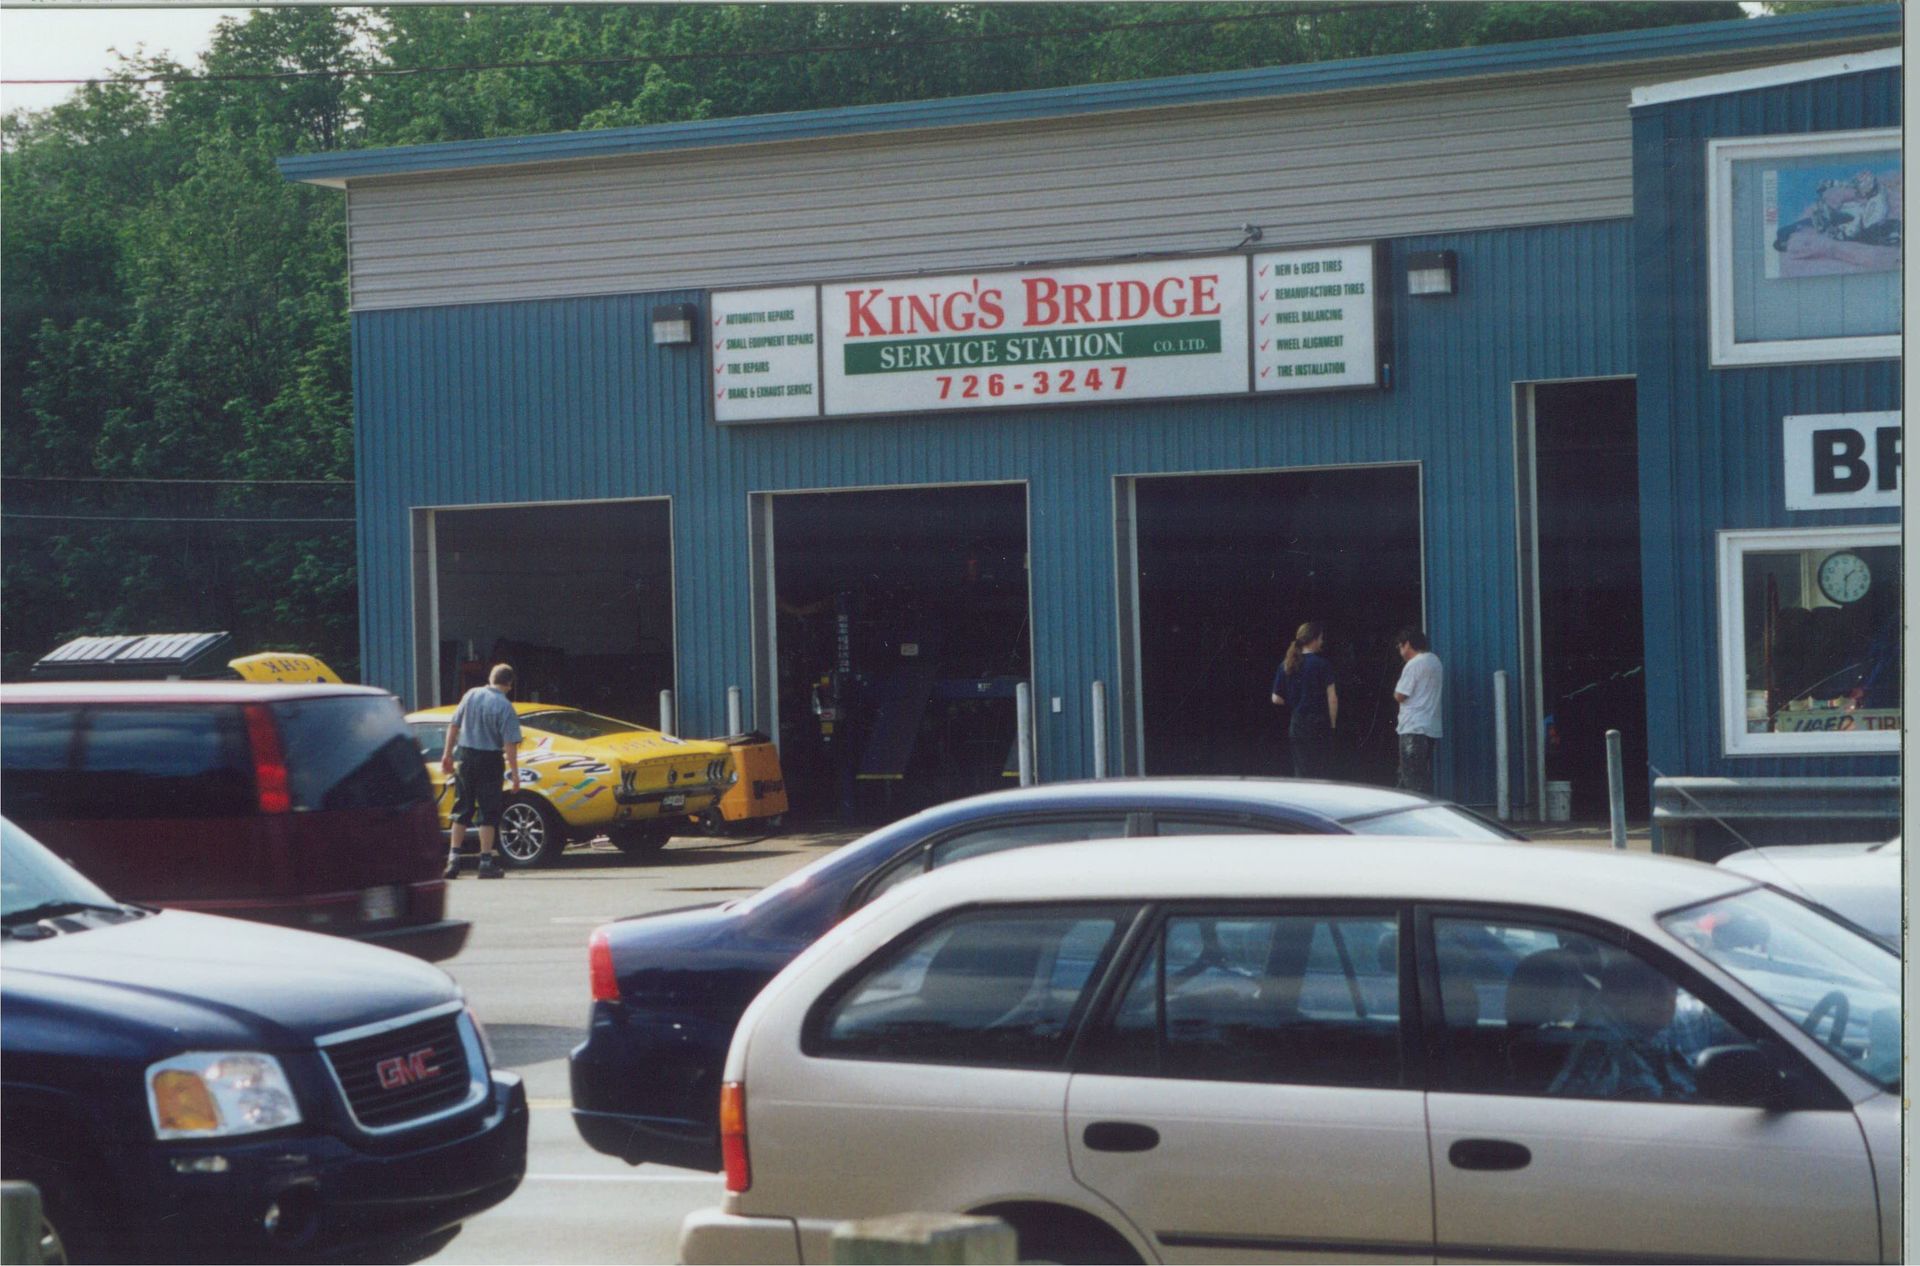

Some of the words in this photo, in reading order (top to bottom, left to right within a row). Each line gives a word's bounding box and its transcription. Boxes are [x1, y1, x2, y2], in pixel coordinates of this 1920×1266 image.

[1275, 264, 1292, 276] NEW
[1293, 262, 1300, 275] &
[1301, 261, 1321, 274] USED
[1322, 260, 1343, 272] TIRES
[1275, 285, 1342, 300] REMANUFACTURED
[1344, 283, 1366, 295] TIRES
[845, 279, 1006, 337] KING'S
[1022, 274, 1222, 326] BRIDGE
[726, 312, 766, 325] AUTOMOTIVE
[767, 310, 794, 322] REPAIRS
[1276, 312, 1300, 324] WHEEL
[1301, 309, 1343, 322] BALANCING
[726, 338, 747, 350] SMALL
[748, 335, 785, 348] EQUIPMENT
[786, 333, 814, 346] REPAIRS
[1276, 338, 1301, 350] WHEEL
[1302, 335, 1343, 349] ALIGNMENT
[880, 341, 999, 369] SERVICE
[1006, 332, 1125, 361] STATION
[1153, 340, 1176, 352] CO.
[1180, 338, 1208, 351] LTD.
[727, 363, 742, 374] TIRE
[742, 361, 770, 373] REPAIRS
[1276, 365, 1294, 377] TIRE
[1294, 362, 1346, 376] INSTALLATION
[936, 366, 1128, 399] 726-3247
[728, 387, 748, 399] BRAKE
[749, 387, 756, 398] &
[756, 385, 785, 398] EXHAUST
[786, 383, 812, 396] SERVICE
[377, 1048, 441, 1089] GMC
